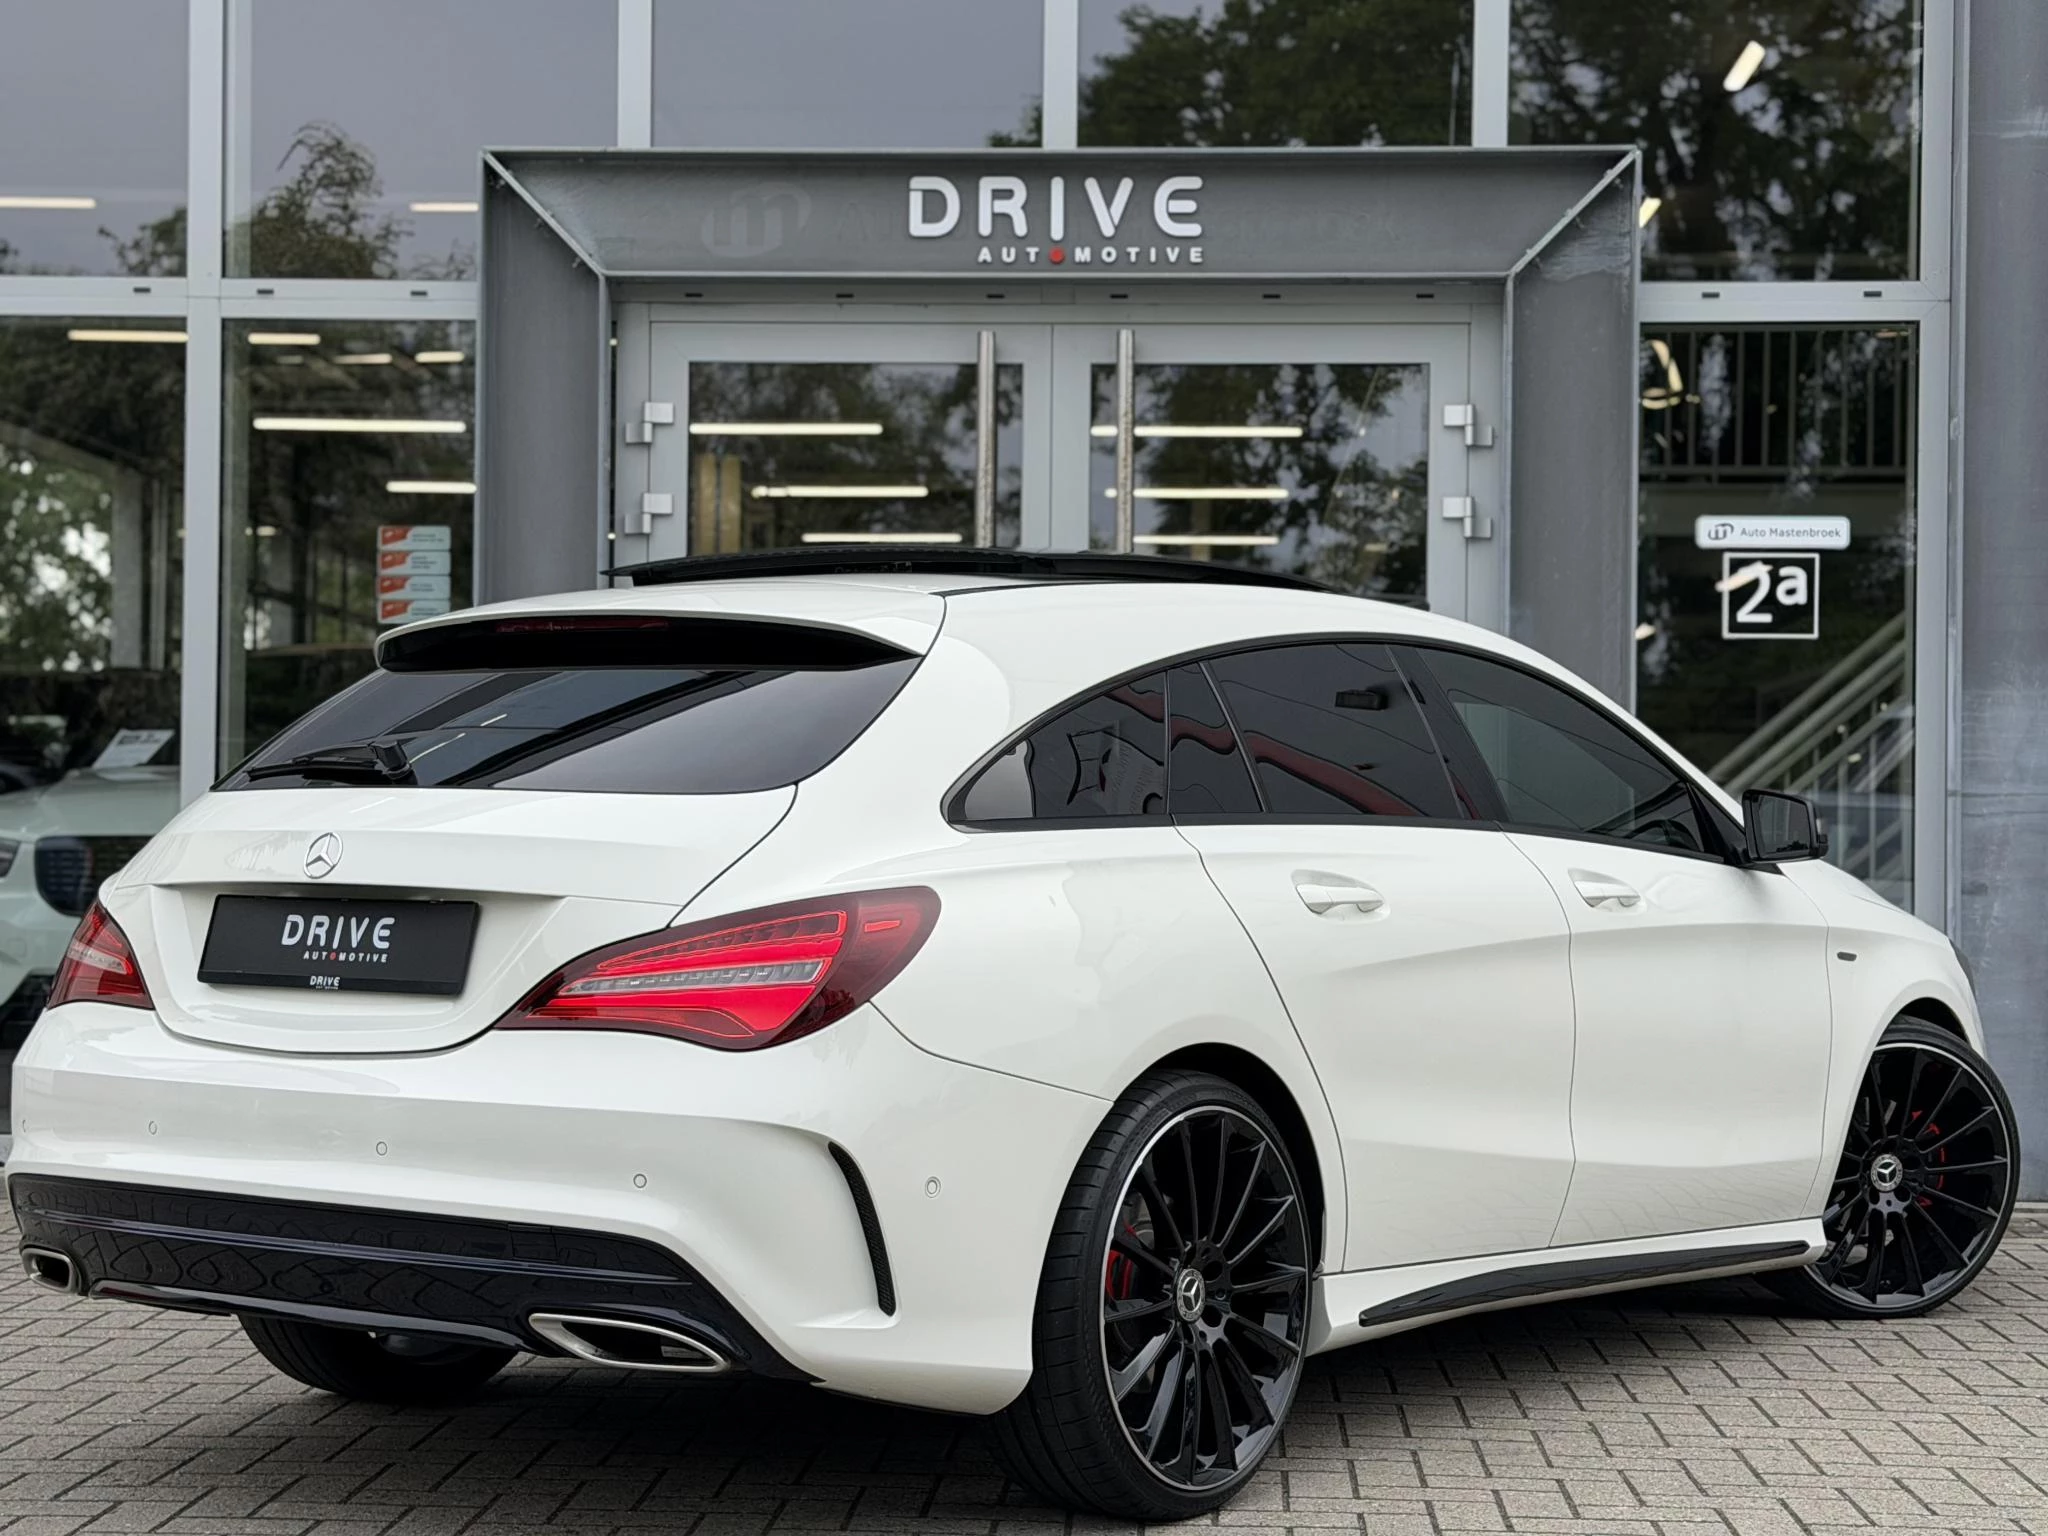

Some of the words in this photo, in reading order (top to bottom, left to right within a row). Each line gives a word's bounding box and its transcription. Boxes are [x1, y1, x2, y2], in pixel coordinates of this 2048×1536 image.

[908, 176, 1203, 241] DRIVE
[1740, 527, 1767, 538] Auto
[1769, 527, 1841, 538] Mastenbroek
[1736, 562, 1808, 623] 2a
[281, 914, 395, 949] DRIVE
[303, 951, 388, 962] AUTOMOTIVE
[310, 975, 340, 986] DRIVE
